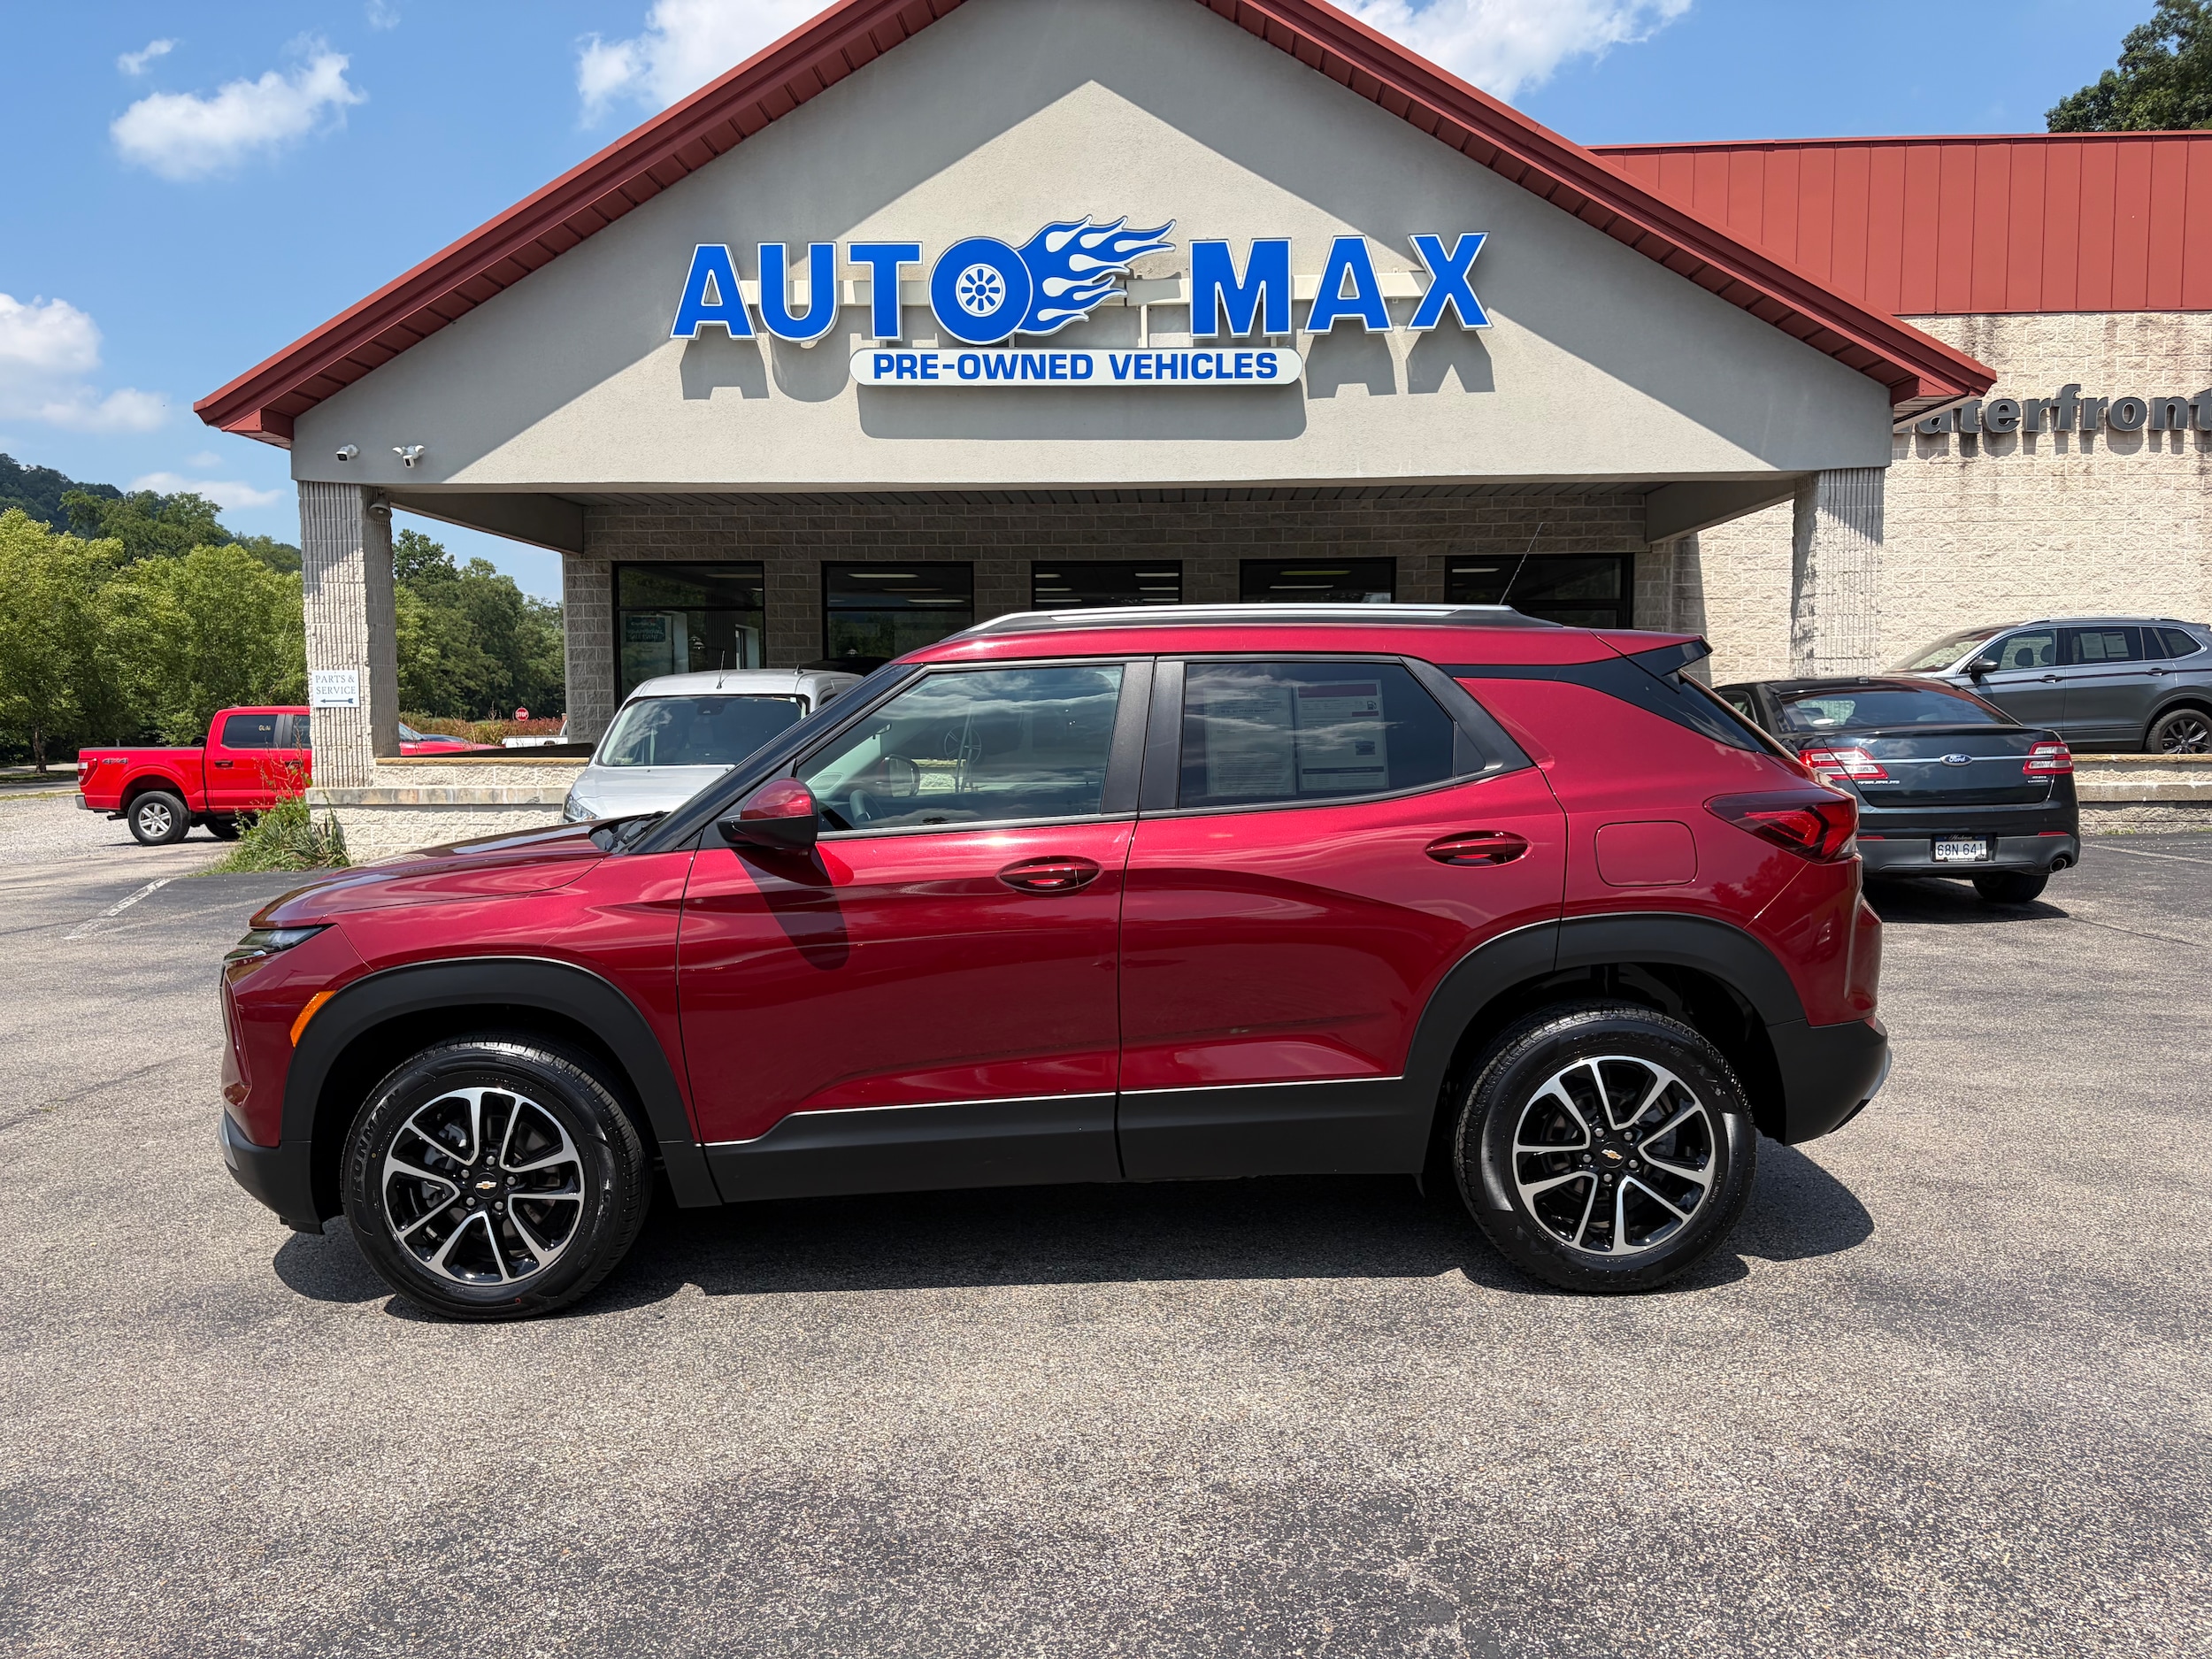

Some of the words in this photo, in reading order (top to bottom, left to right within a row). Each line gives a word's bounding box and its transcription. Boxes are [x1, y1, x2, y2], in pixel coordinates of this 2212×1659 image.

[670, 236, 1033, 345] AUTO
[1190, 231, 1493, 338] MAX
[873, 354, 1093, 380] PRE-OWNED
[1110, 352, 1278, 380] VEHICLES
[1895, 383, 2212, 434] aterfront
[315, 674, 346, 684] PARTS
[348, 674, 355, 683] &
[316, 686, 356, 695] SERVICE
[1962, 843, 1983, 856] 641
